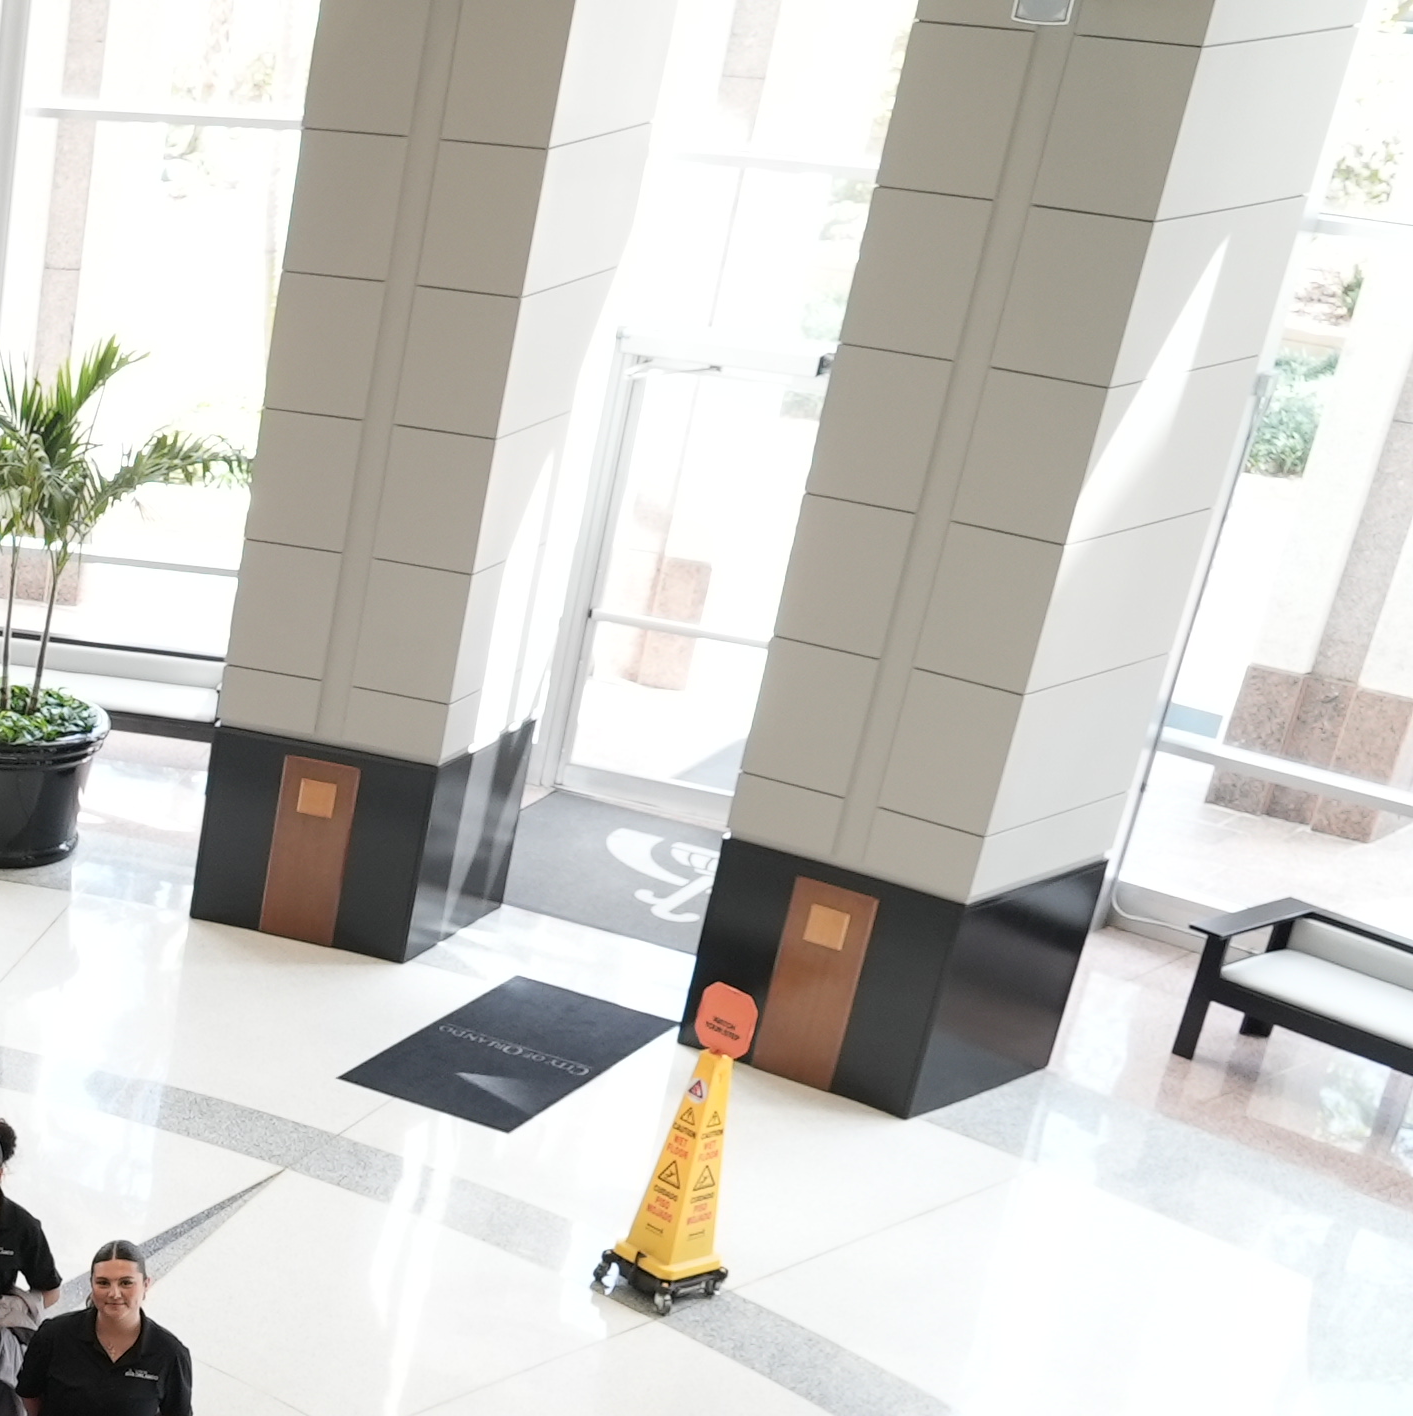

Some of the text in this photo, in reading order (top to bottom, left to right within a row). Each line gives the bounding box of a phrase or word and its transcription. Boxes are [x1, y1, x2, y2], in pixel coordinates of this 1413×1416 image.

[438, 1025, 591, 1077] CITY OF ORLANDO
